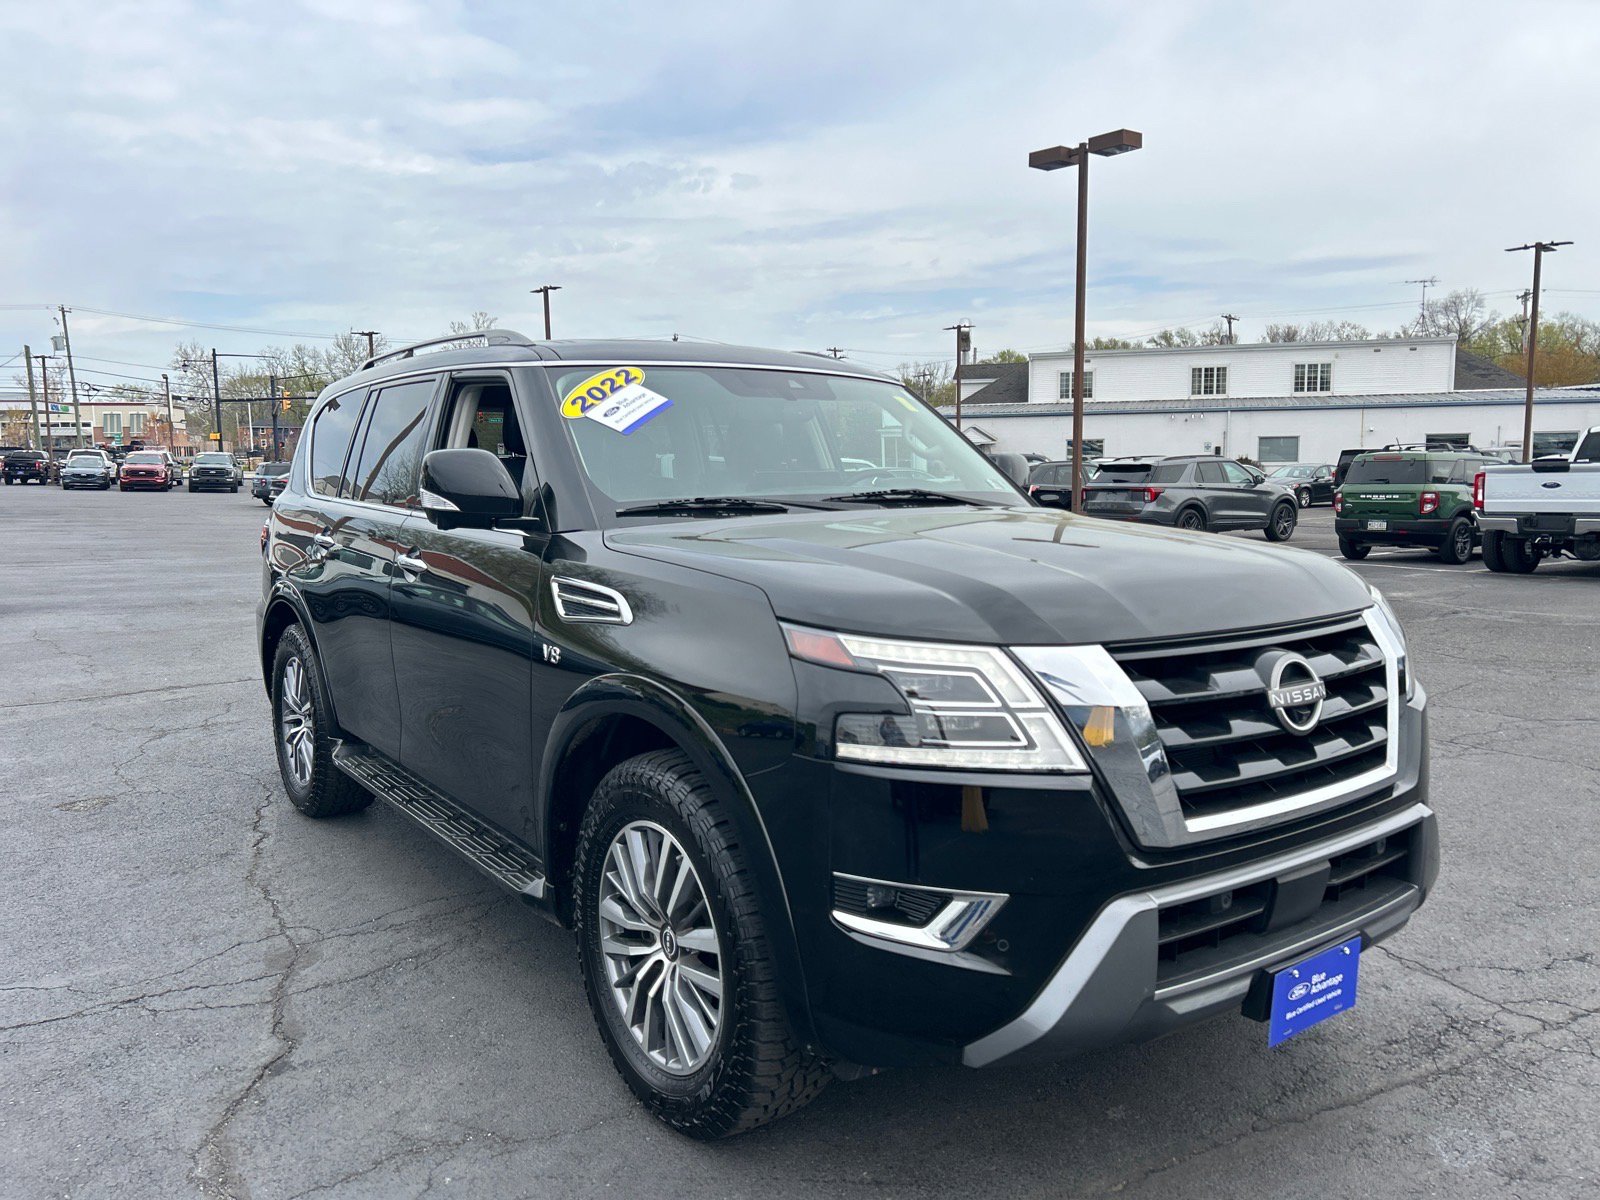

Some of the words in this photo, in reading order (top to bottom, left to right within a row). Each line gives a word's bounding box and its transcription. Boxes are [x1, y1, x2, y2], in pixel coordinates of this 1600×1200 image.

[571, 369, 638, 413] 2022
[542, 643, 561, 664] V8
[1271, 684, 1326, 706] NISSAN
